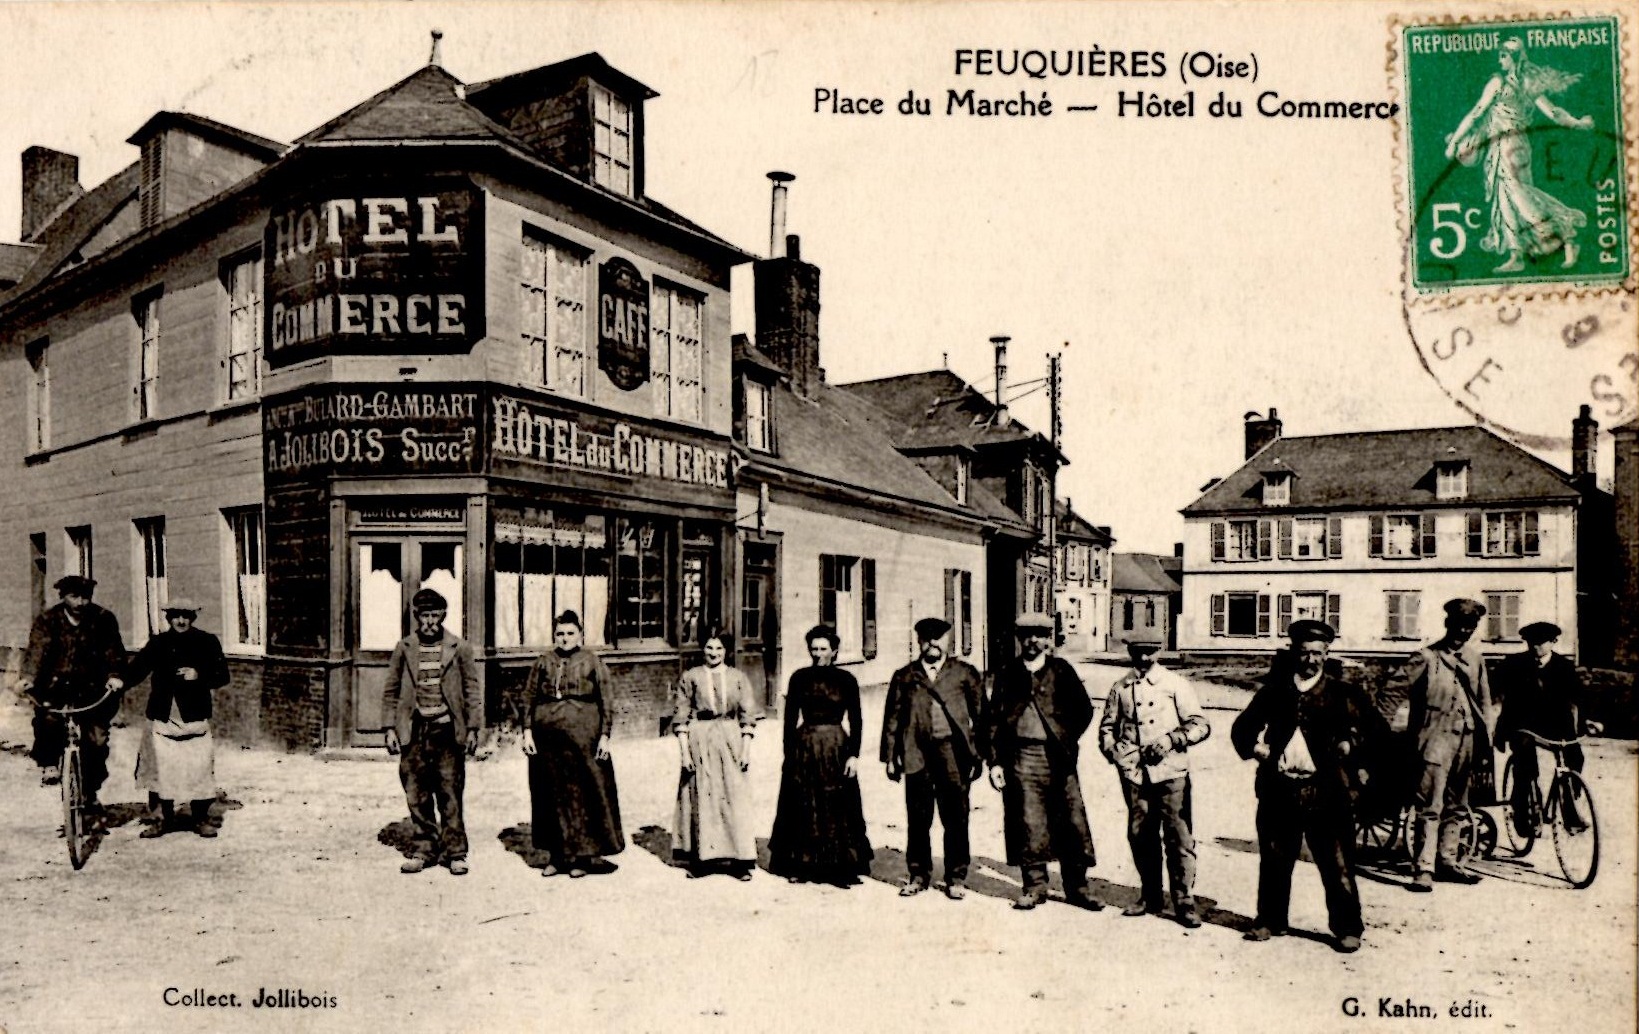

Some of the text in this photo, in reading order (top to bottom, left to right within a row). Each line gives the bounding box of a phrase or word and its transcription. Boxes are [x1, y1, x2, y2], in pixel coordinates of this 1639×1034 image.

[1527, 27, 1609, 49] FRANÇAISE
[1597, 178, 1618, 263] POSTES
[271, 294, 466, 350] COMMERCE
[614, 423, 728, 489] COMMERCE
